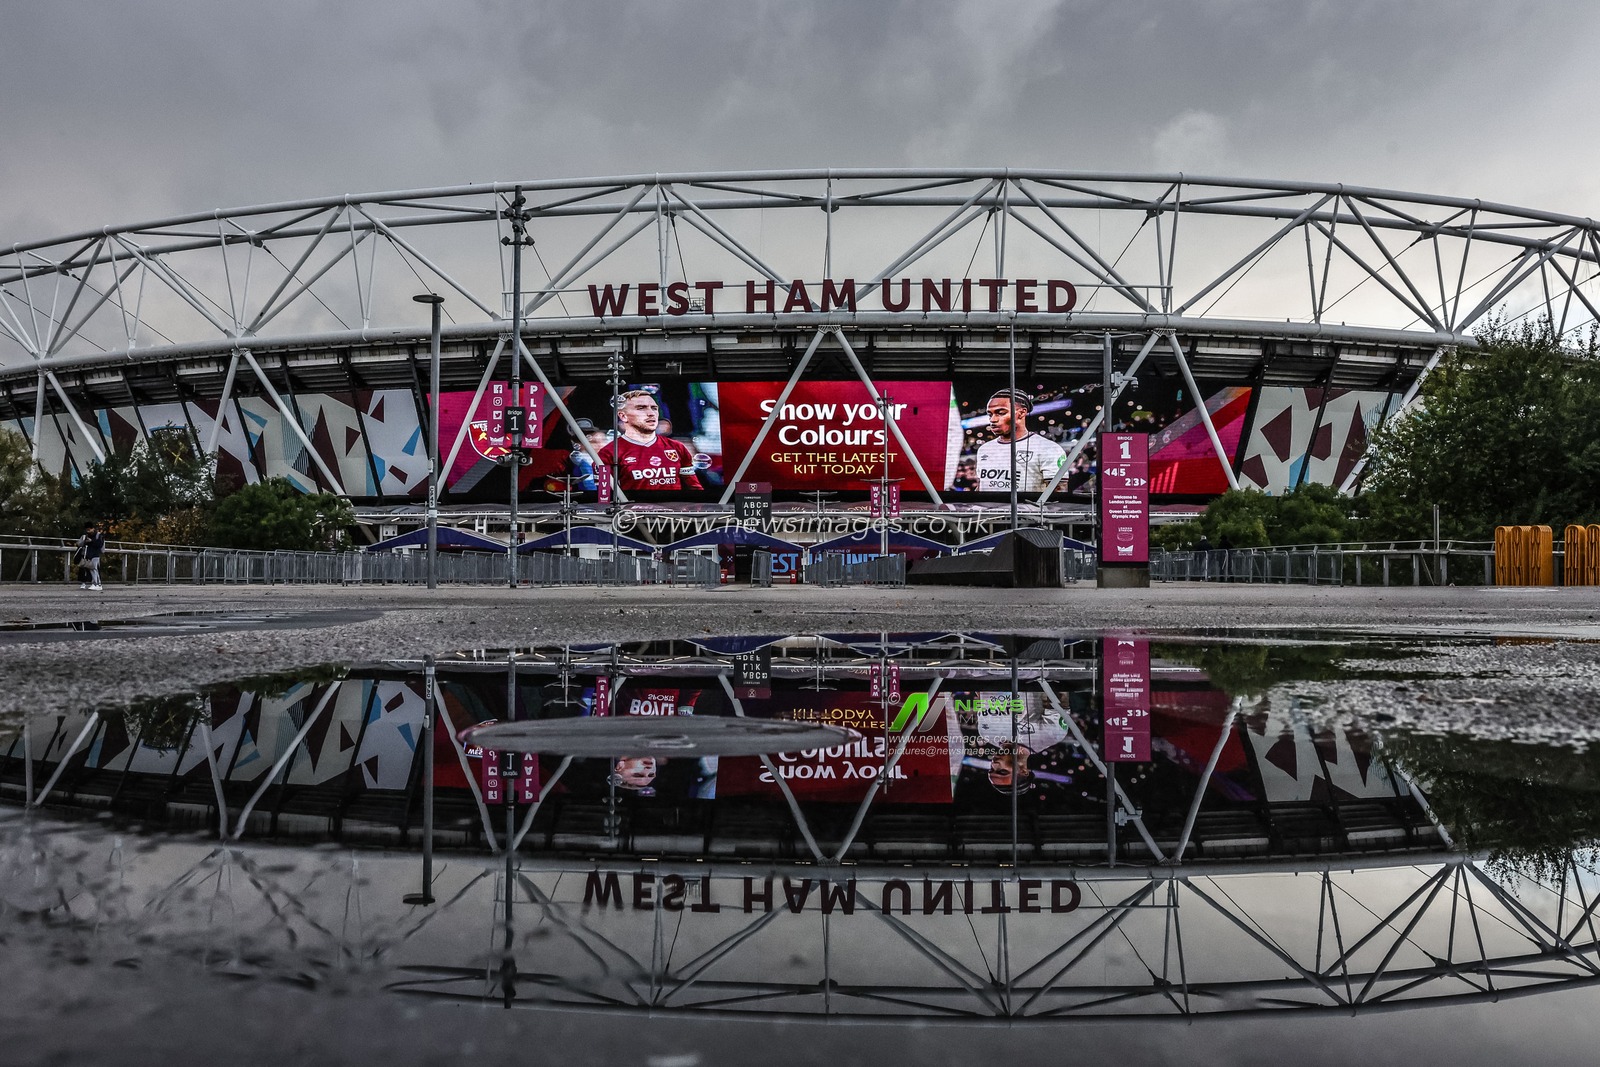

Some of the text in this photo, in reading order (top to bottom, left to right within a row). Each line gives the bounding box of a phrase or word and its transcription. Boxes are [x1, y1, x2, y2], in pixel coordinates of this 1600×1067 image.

[588, 278, 1077, 317] WEST HAM UNITED
[528, 385, 538, 434] PLAY
[510, 416, 519, 431] 1
[778, 425, 888, 446] Colours
[771, 452, 898, 463] GET THE LATEST
[1120, 441, 1131, 459] 1
[631, 467, 677, 480] BOYLE
[794, 464, 875, 474] KIT TODAY
[649, 478, 676, 486] SPORTS
[771, 553, 798, 573] EST
